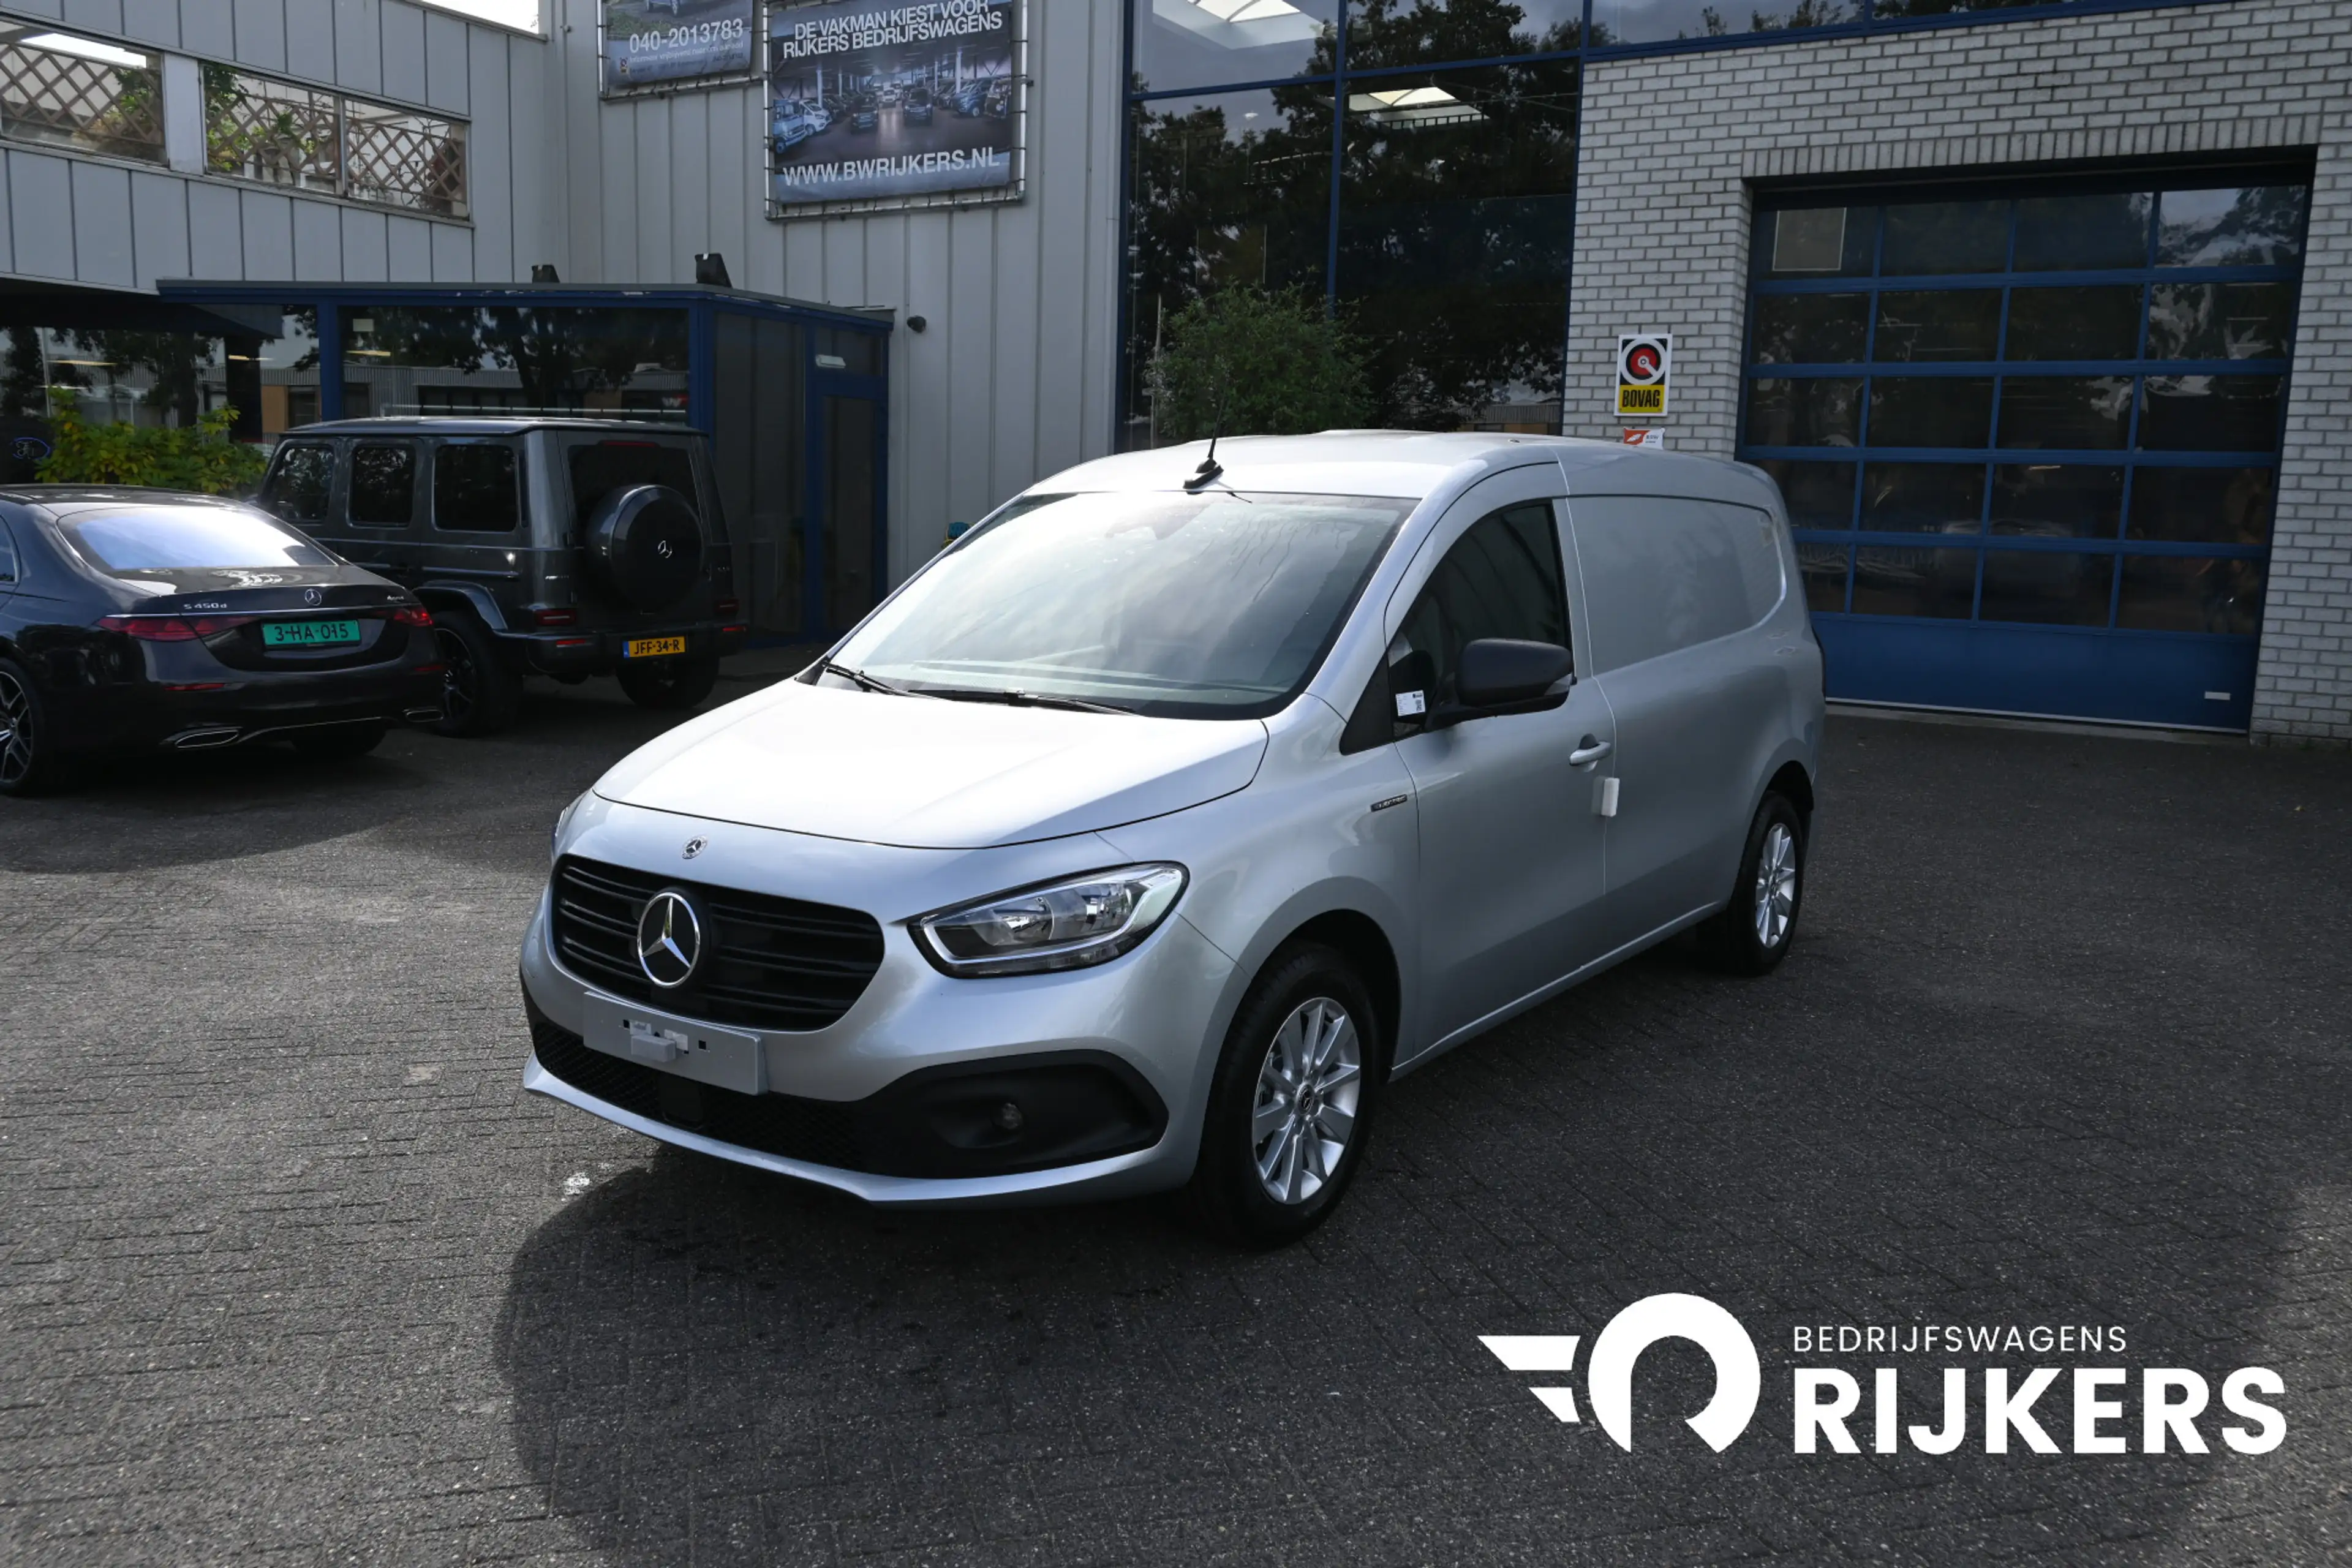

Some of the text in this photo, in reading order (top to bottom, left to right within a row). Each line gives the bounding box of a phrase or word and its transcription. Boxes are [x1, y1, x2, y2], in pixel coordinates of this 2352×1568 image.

[630, 18, 743, 53] 040-2013783
[783, 11, 1002, 58] RIJKERS BEDRIJFSWAGENS
[795, 0, 988, 40] DE VAKMAN KIEST VOOR
[783, 146, 1000, 186] WWW.BWRIJKERS.NL
[1622, 389, 1660, 408] BOVAG
[274, 622, 349, 642] 3-HA-015
[634, 639, 680, 655] JFF-34-R
